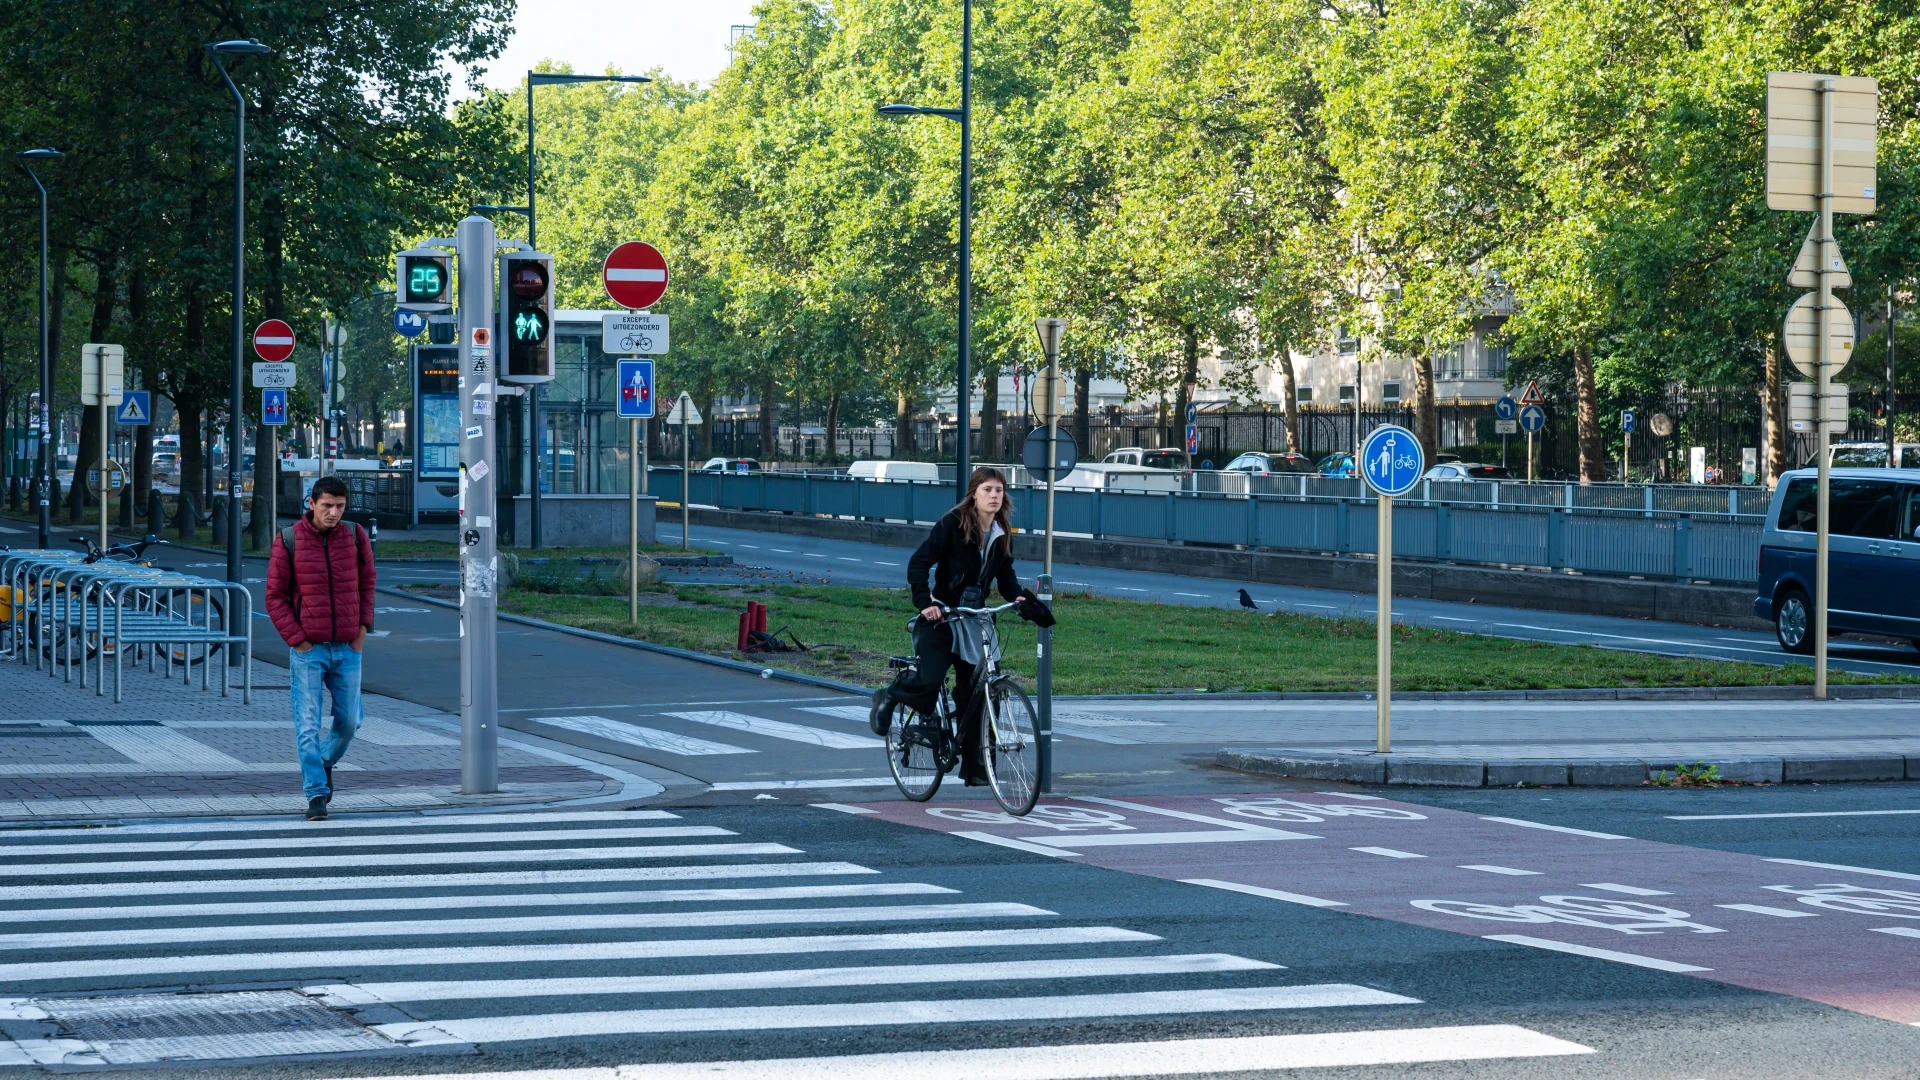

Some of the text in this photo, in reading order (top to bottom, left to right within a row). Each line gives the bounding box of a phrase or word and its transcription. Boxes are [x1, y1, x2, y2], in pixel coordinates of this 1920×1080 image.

[411, 268, 439, 292] 25
[612, 323, 660, 331] UITGEZONDERD
[1623, 413, 1633, 429] P
